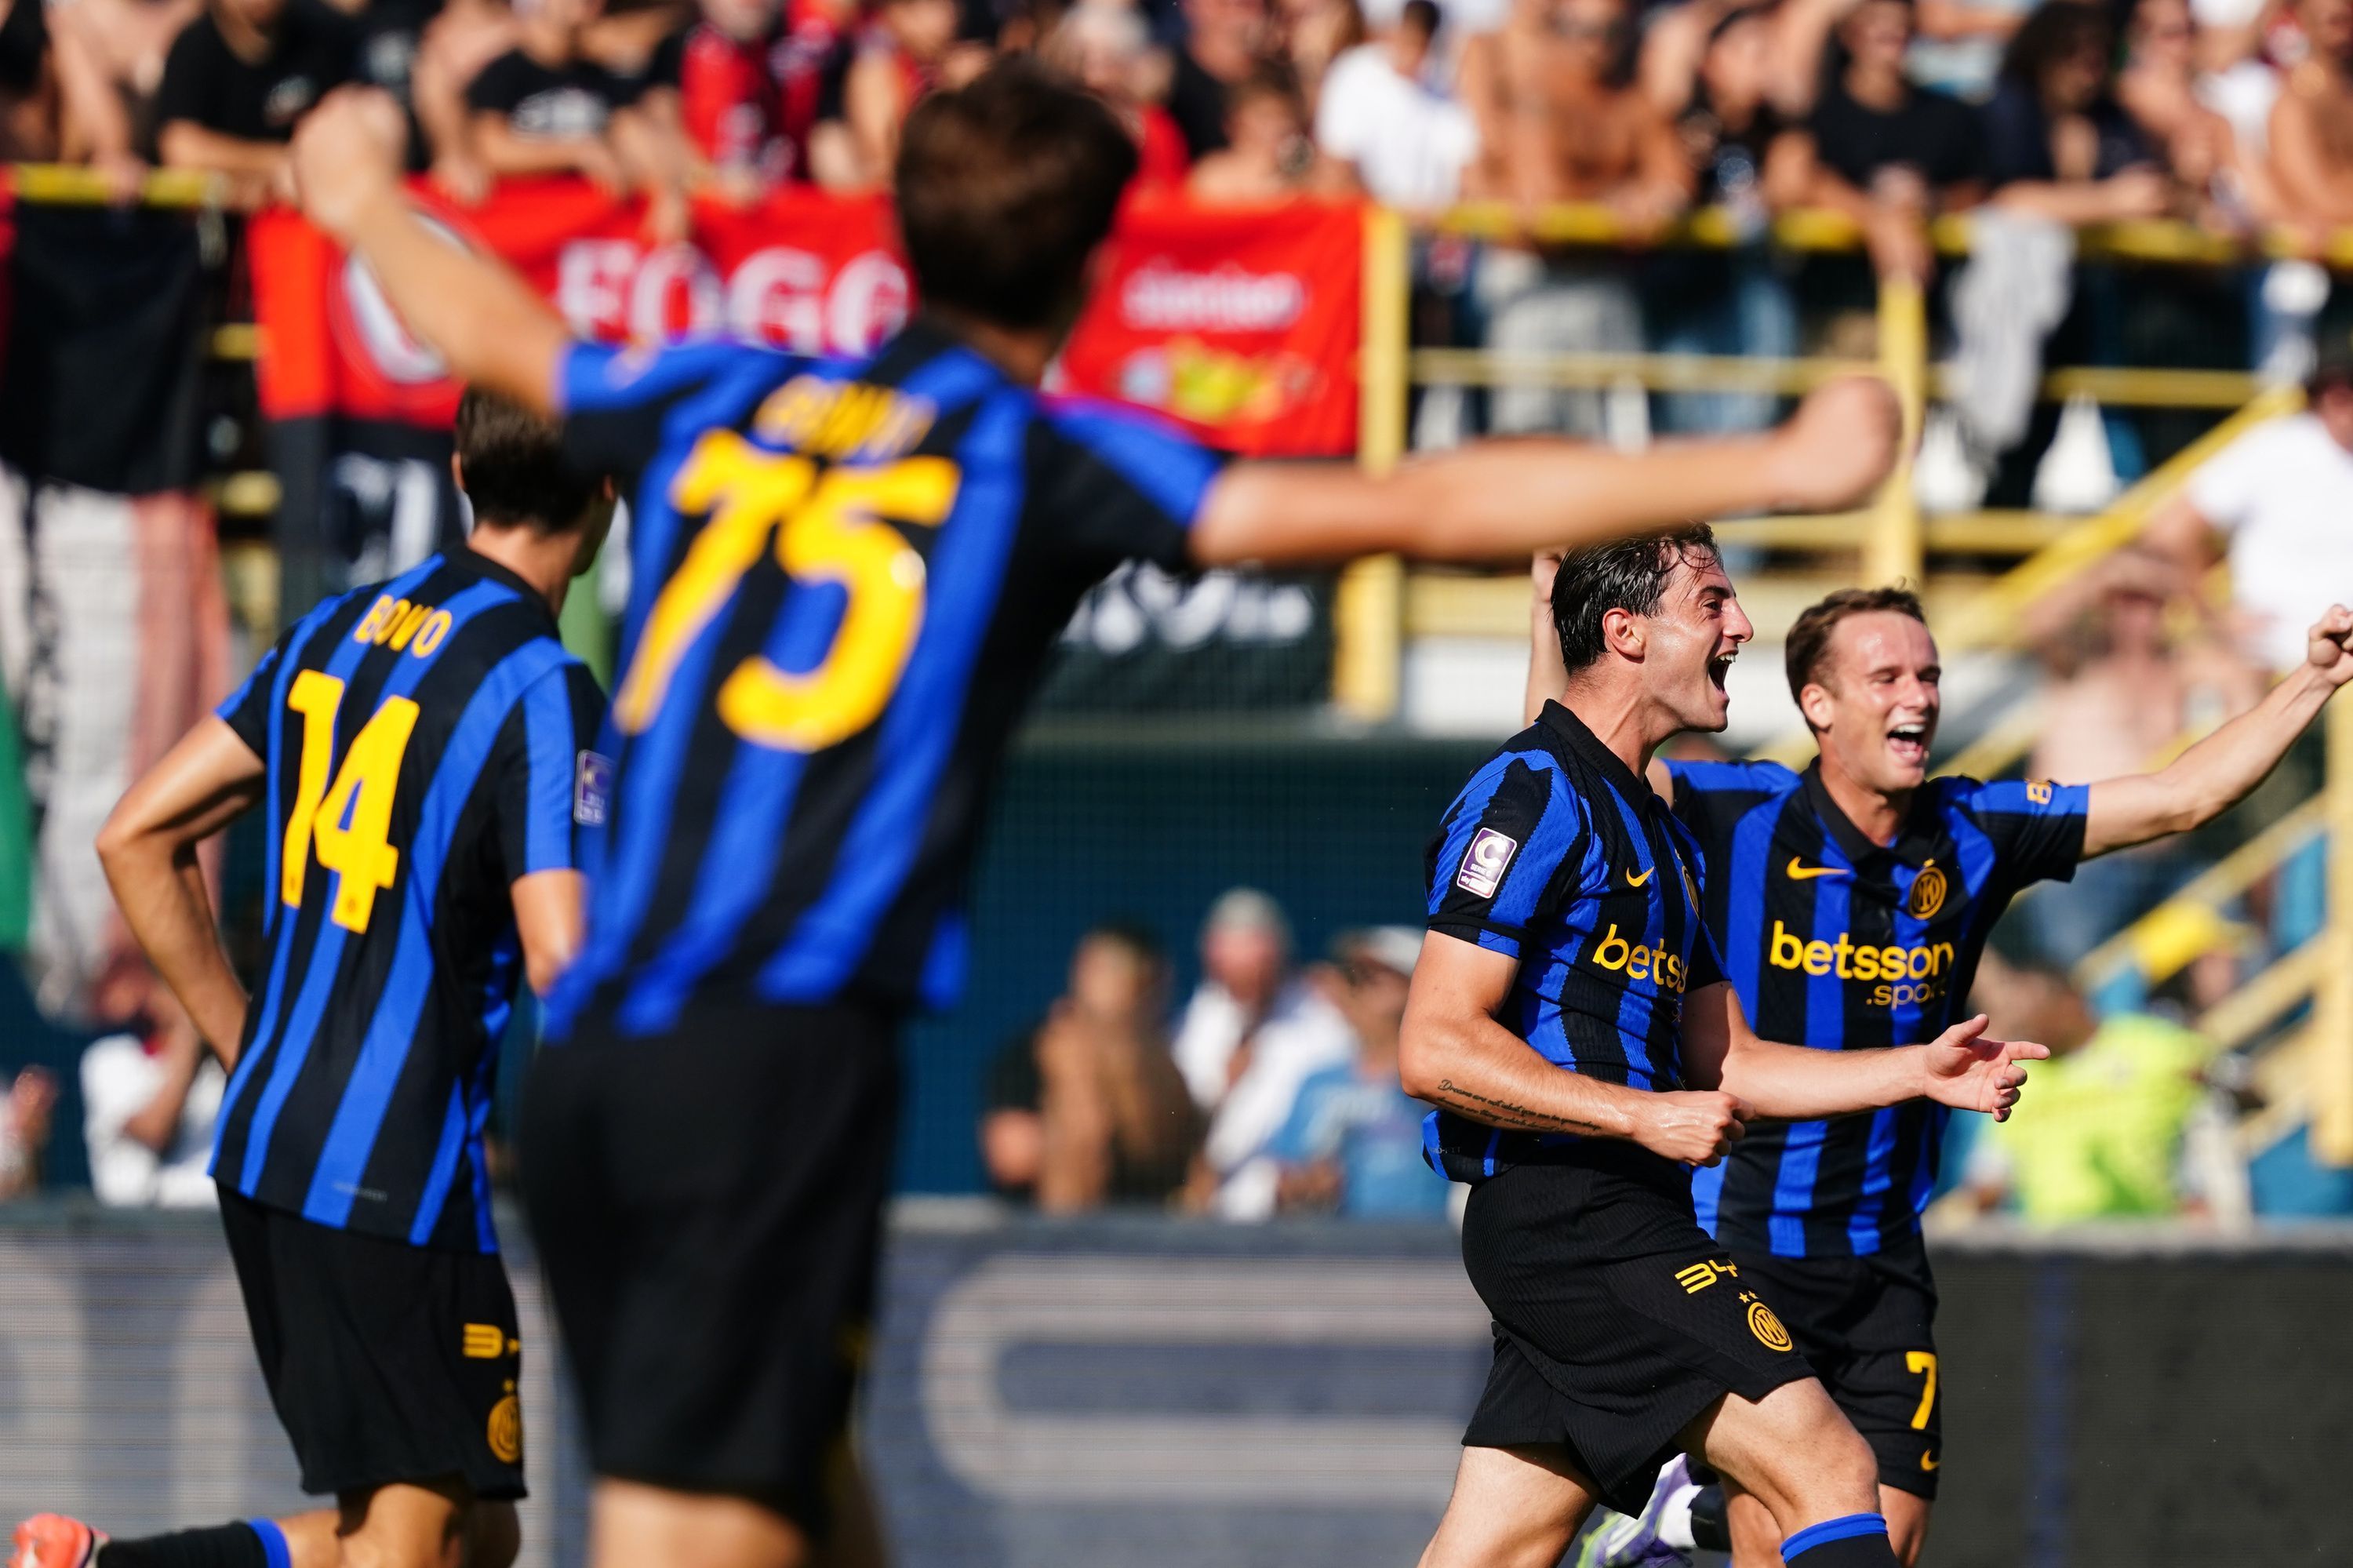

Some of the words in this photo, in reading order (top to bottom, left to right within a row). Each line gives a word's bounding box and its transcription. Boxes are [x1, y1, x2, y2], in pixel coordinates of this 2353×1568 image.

[353, 595, 453, 657] BOVO
[612, 427, 961, 753] 75
[282, 668, 420, 934] 14
[1769, 920, 1954, 980] betsson
[1905, 1351, 1937, 1430] 7
